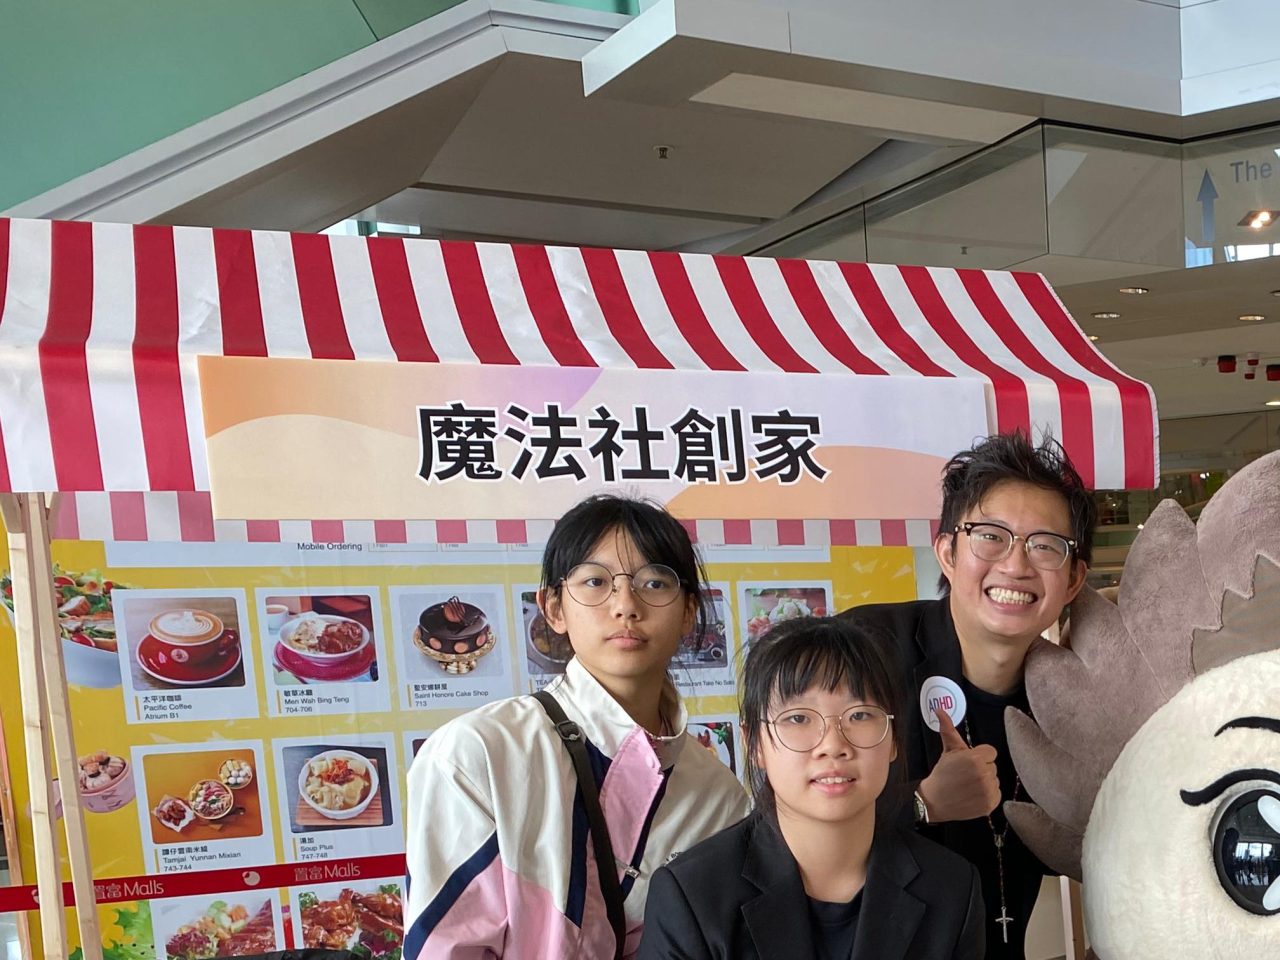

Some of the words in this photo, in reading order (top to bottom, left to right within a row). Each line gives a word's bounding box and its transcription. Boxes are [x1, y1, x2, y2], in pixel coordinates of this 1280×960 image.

[1230, 159, 1273, 183] The
[417, 402, 829, 485] 魔法社創家
[297, 542, 325, 551] Mobile
[326, 542, 363, 552] Ordering
[455, 690, 472, 698] Cake
[473, 690, 489, 698] Shop
[143, 703, 167, 712] Pacific
[169, 703, 193, 711] Coffee
[415, 700, 428, 708] 713
[928, 695, 954, 712] ADHD
[163, 856, 187, 865] Tamjai
[190, 854, 217, 862] Yunnan
[218, 852, 241, 860] Mixian
[164, 864, 192, 872] 743-744
[324, 861, 361, 879] Malls
[123, 879, 165, 897] Malls
